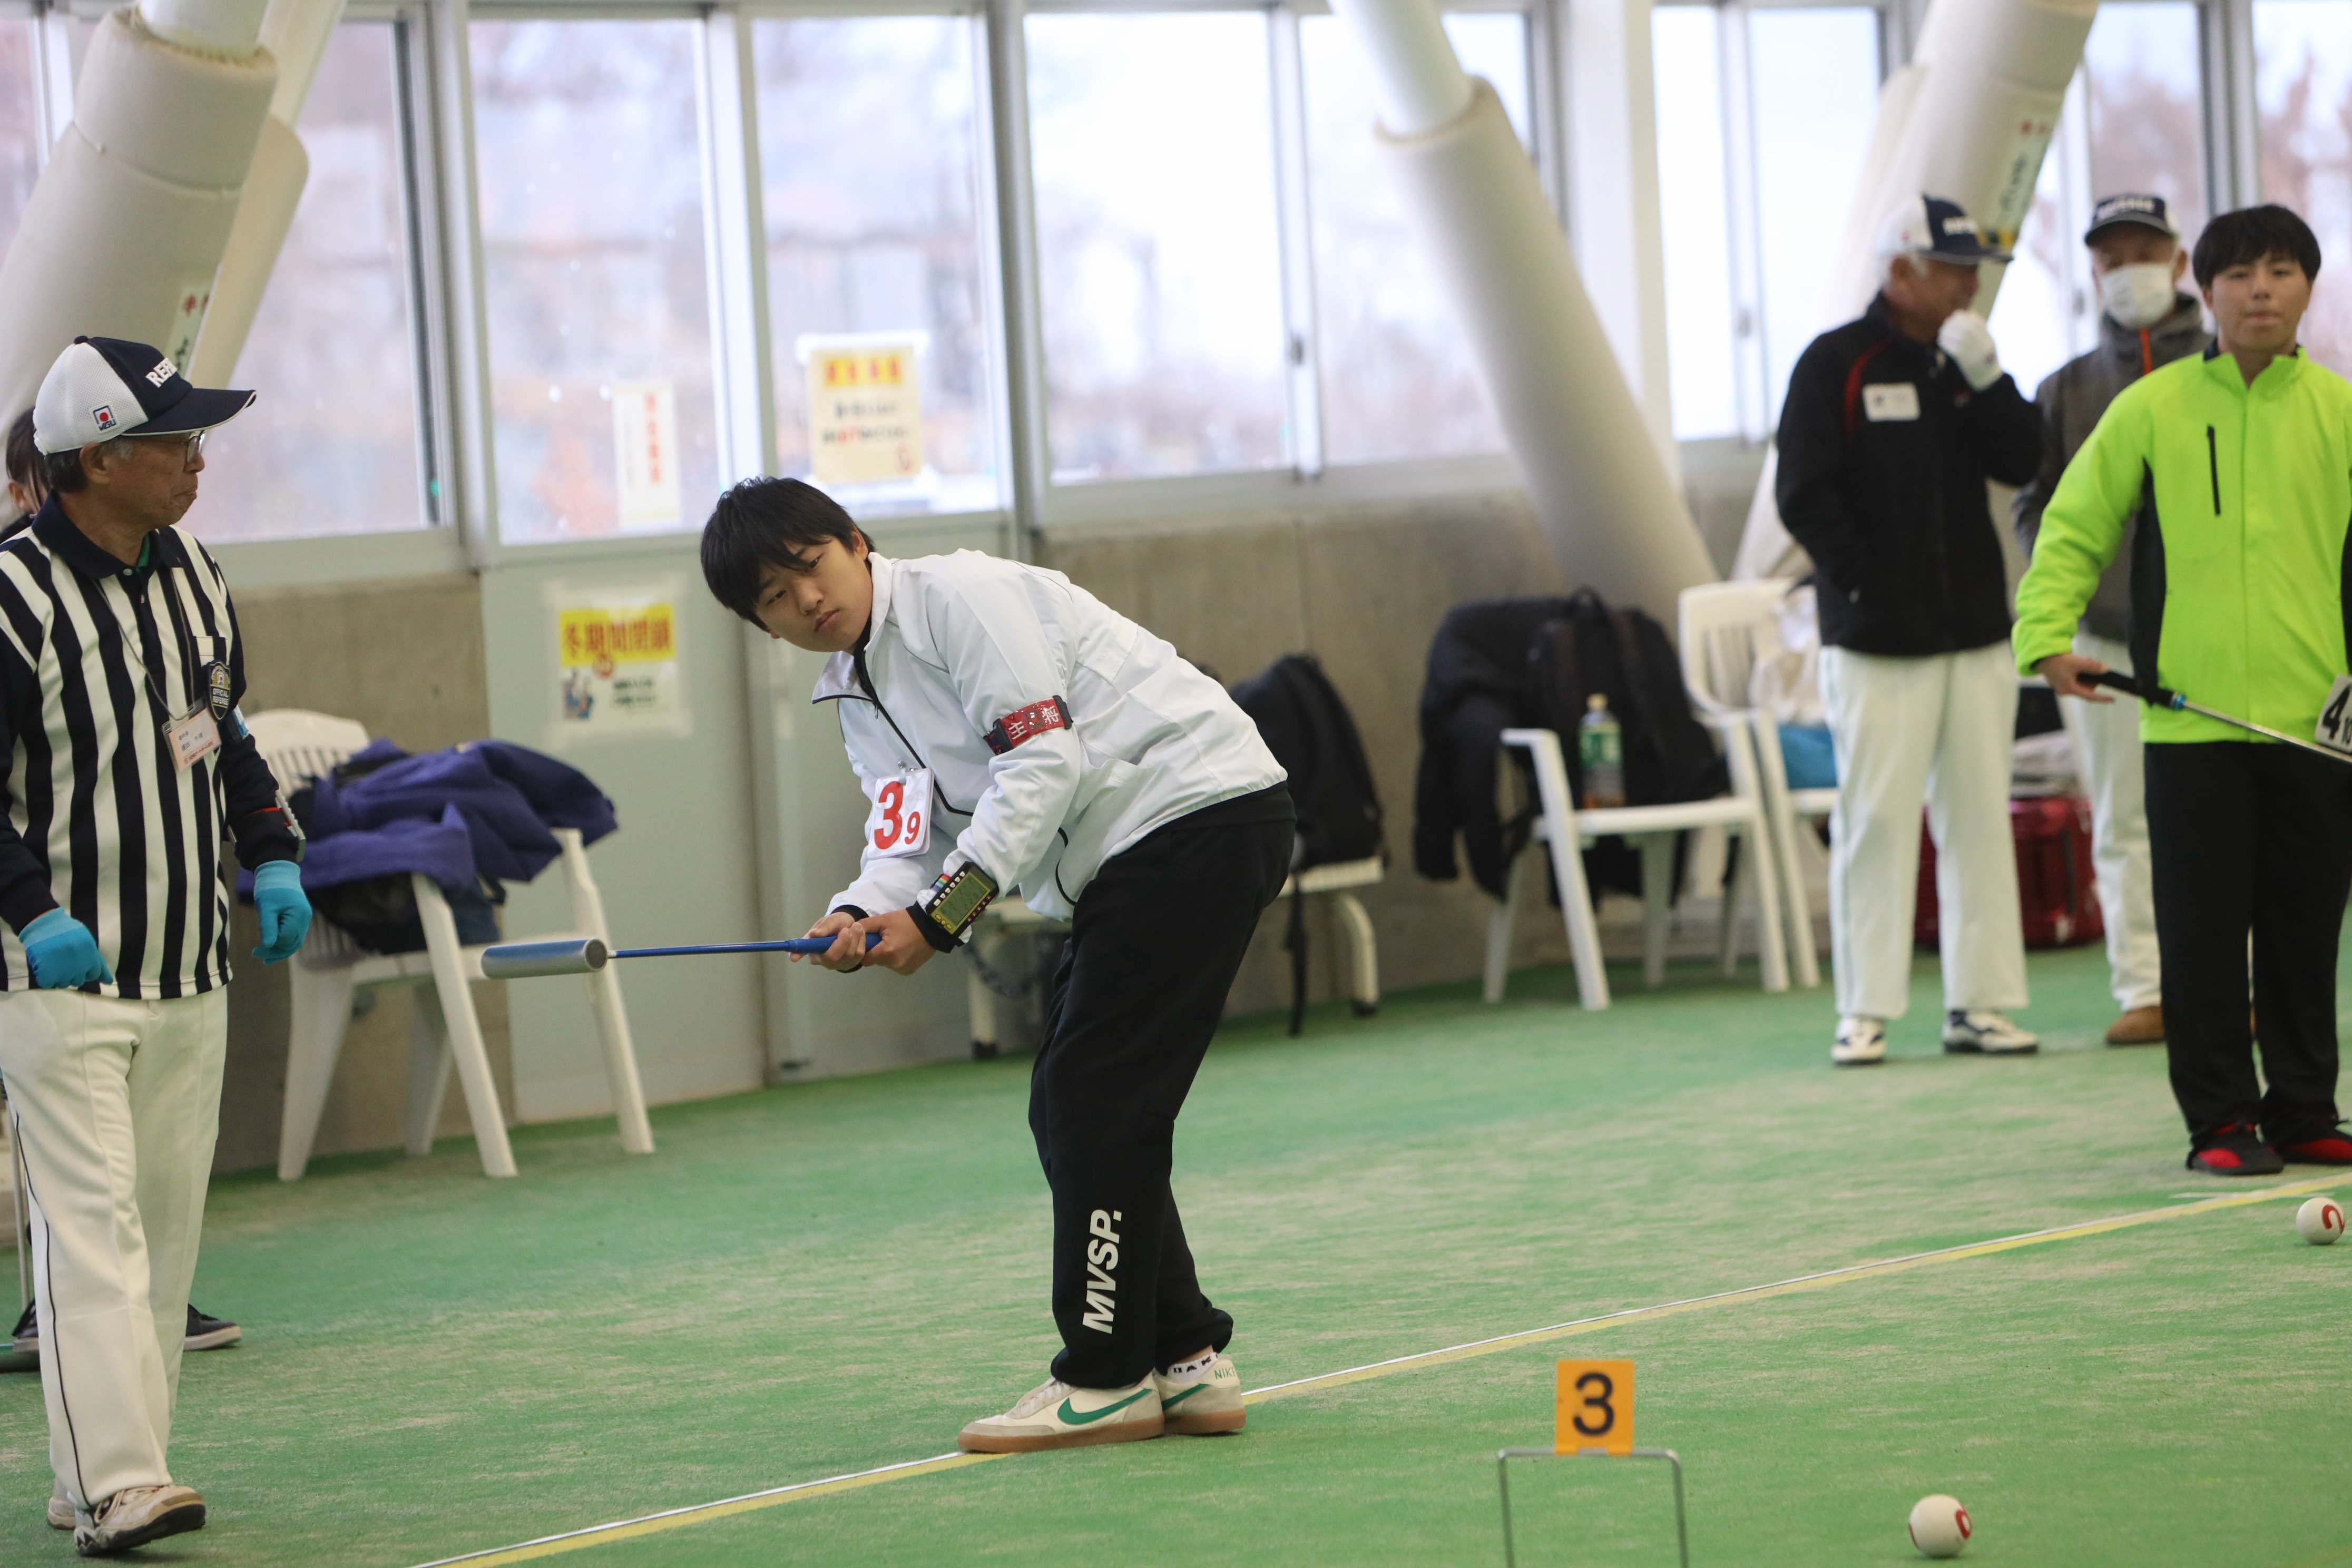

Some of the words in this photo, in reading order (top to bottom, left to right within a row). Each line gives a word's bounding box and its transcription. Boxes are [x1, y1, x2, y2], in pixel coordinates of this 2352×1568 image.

[2322, 684, 2352, 740] 4
[874, 781, 904, 850] 3
[905, 811, 920, 845] 9
[1082, 1209, 1122, 1334] MVSP.
[1573, 1372, 1614, 1436] 3
